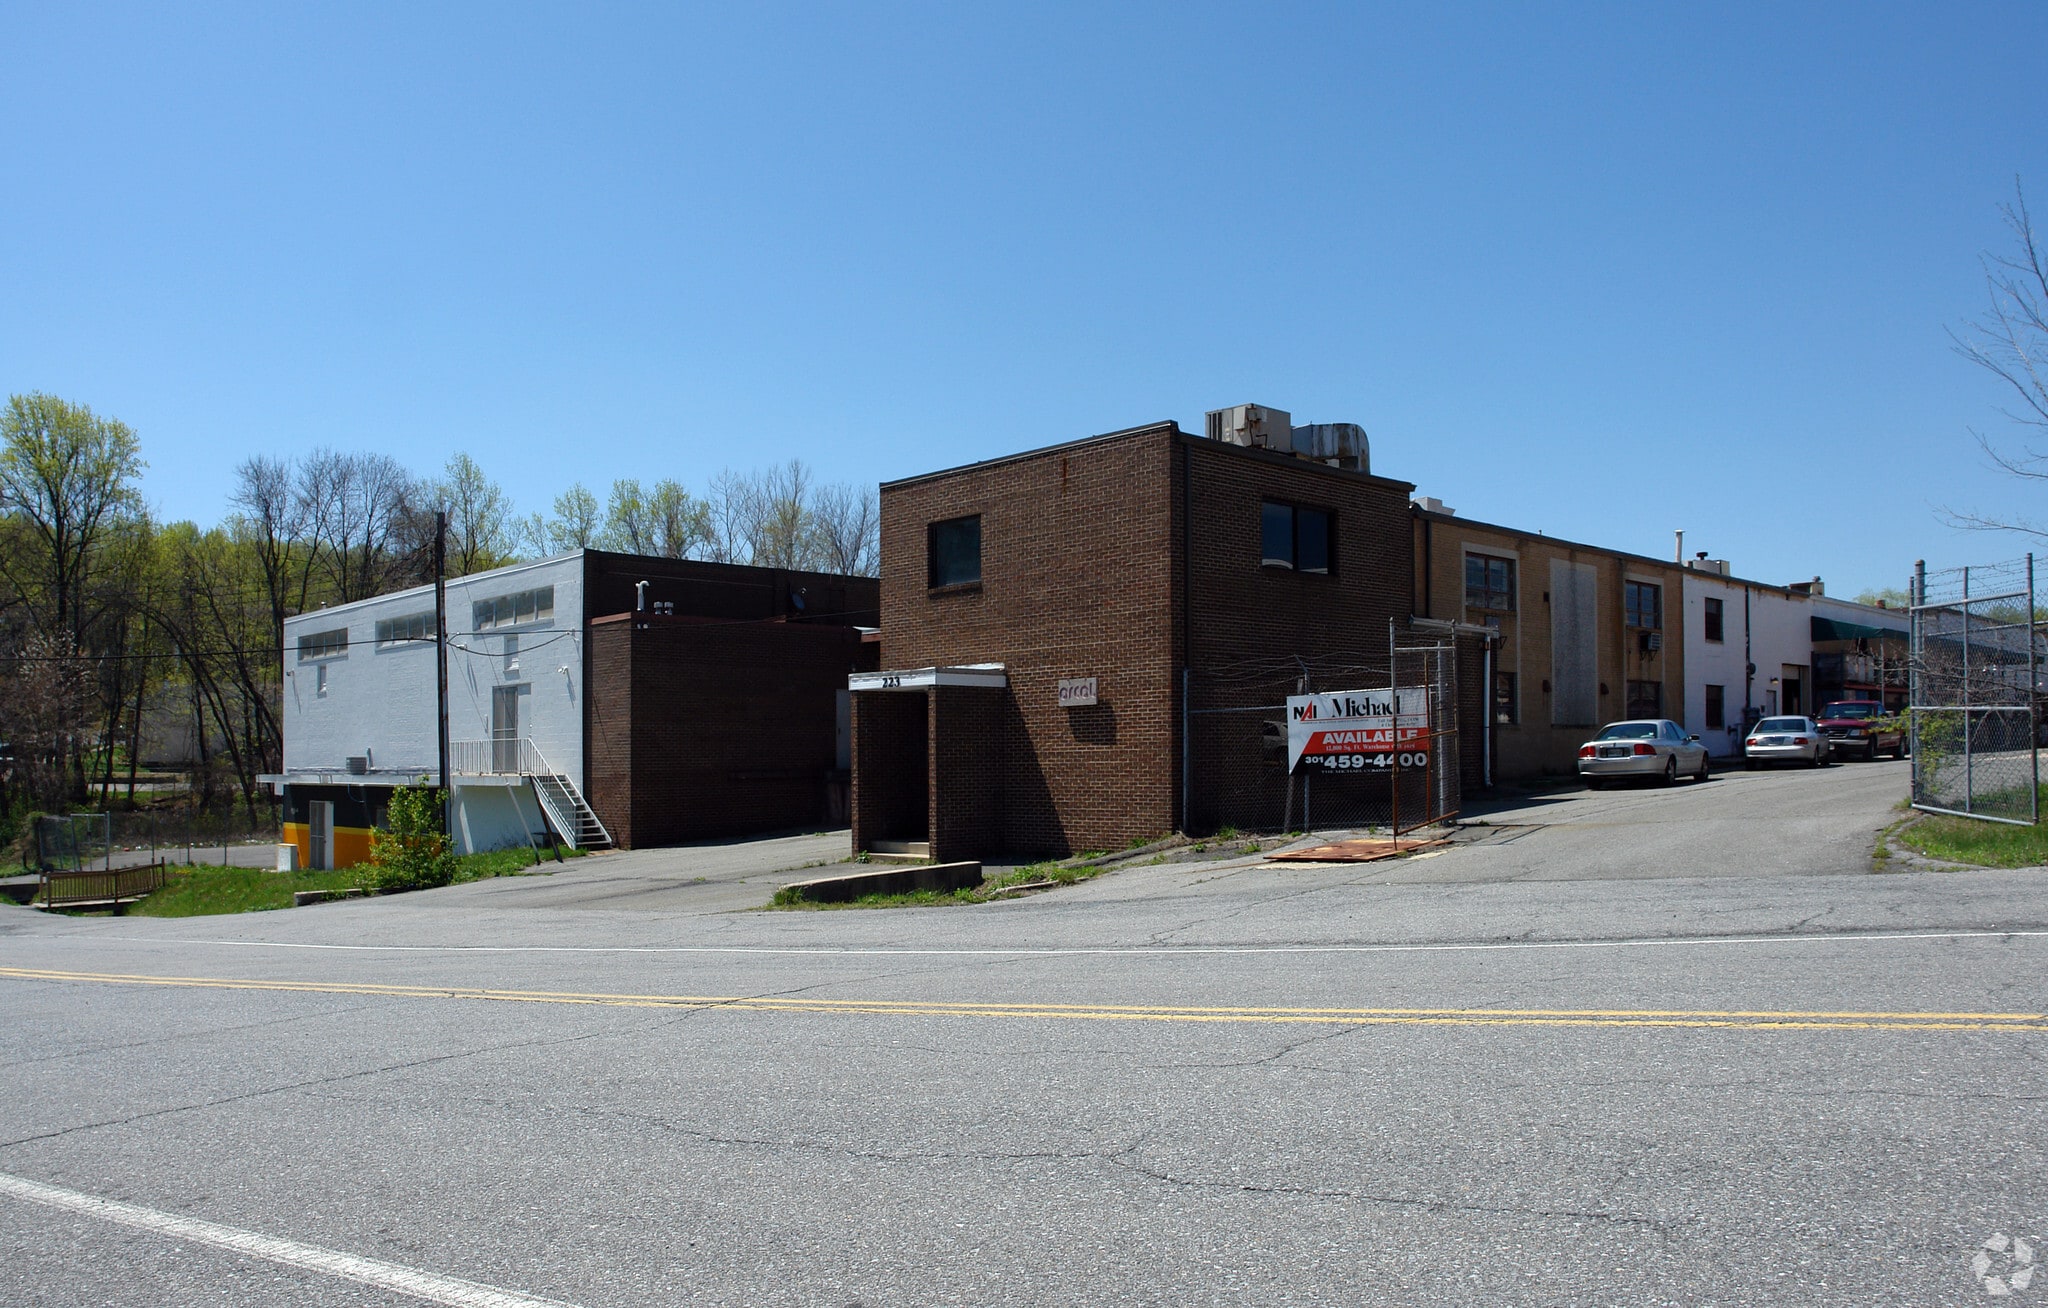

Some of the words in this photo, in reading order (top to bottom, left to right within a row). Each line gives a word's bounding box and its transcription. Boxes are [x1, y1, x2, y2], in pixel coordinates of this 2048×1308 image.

[882, 676, 900, 688] 223
[1293, 700, 1317, 721] NAI
[1332, 695, 1400, 717] Michael
[1322, 730, 1418, 745] AVAILABLE
[1305, 756, 1324, 764] 301
[1324, 752, 1428, 769] 459-4400
